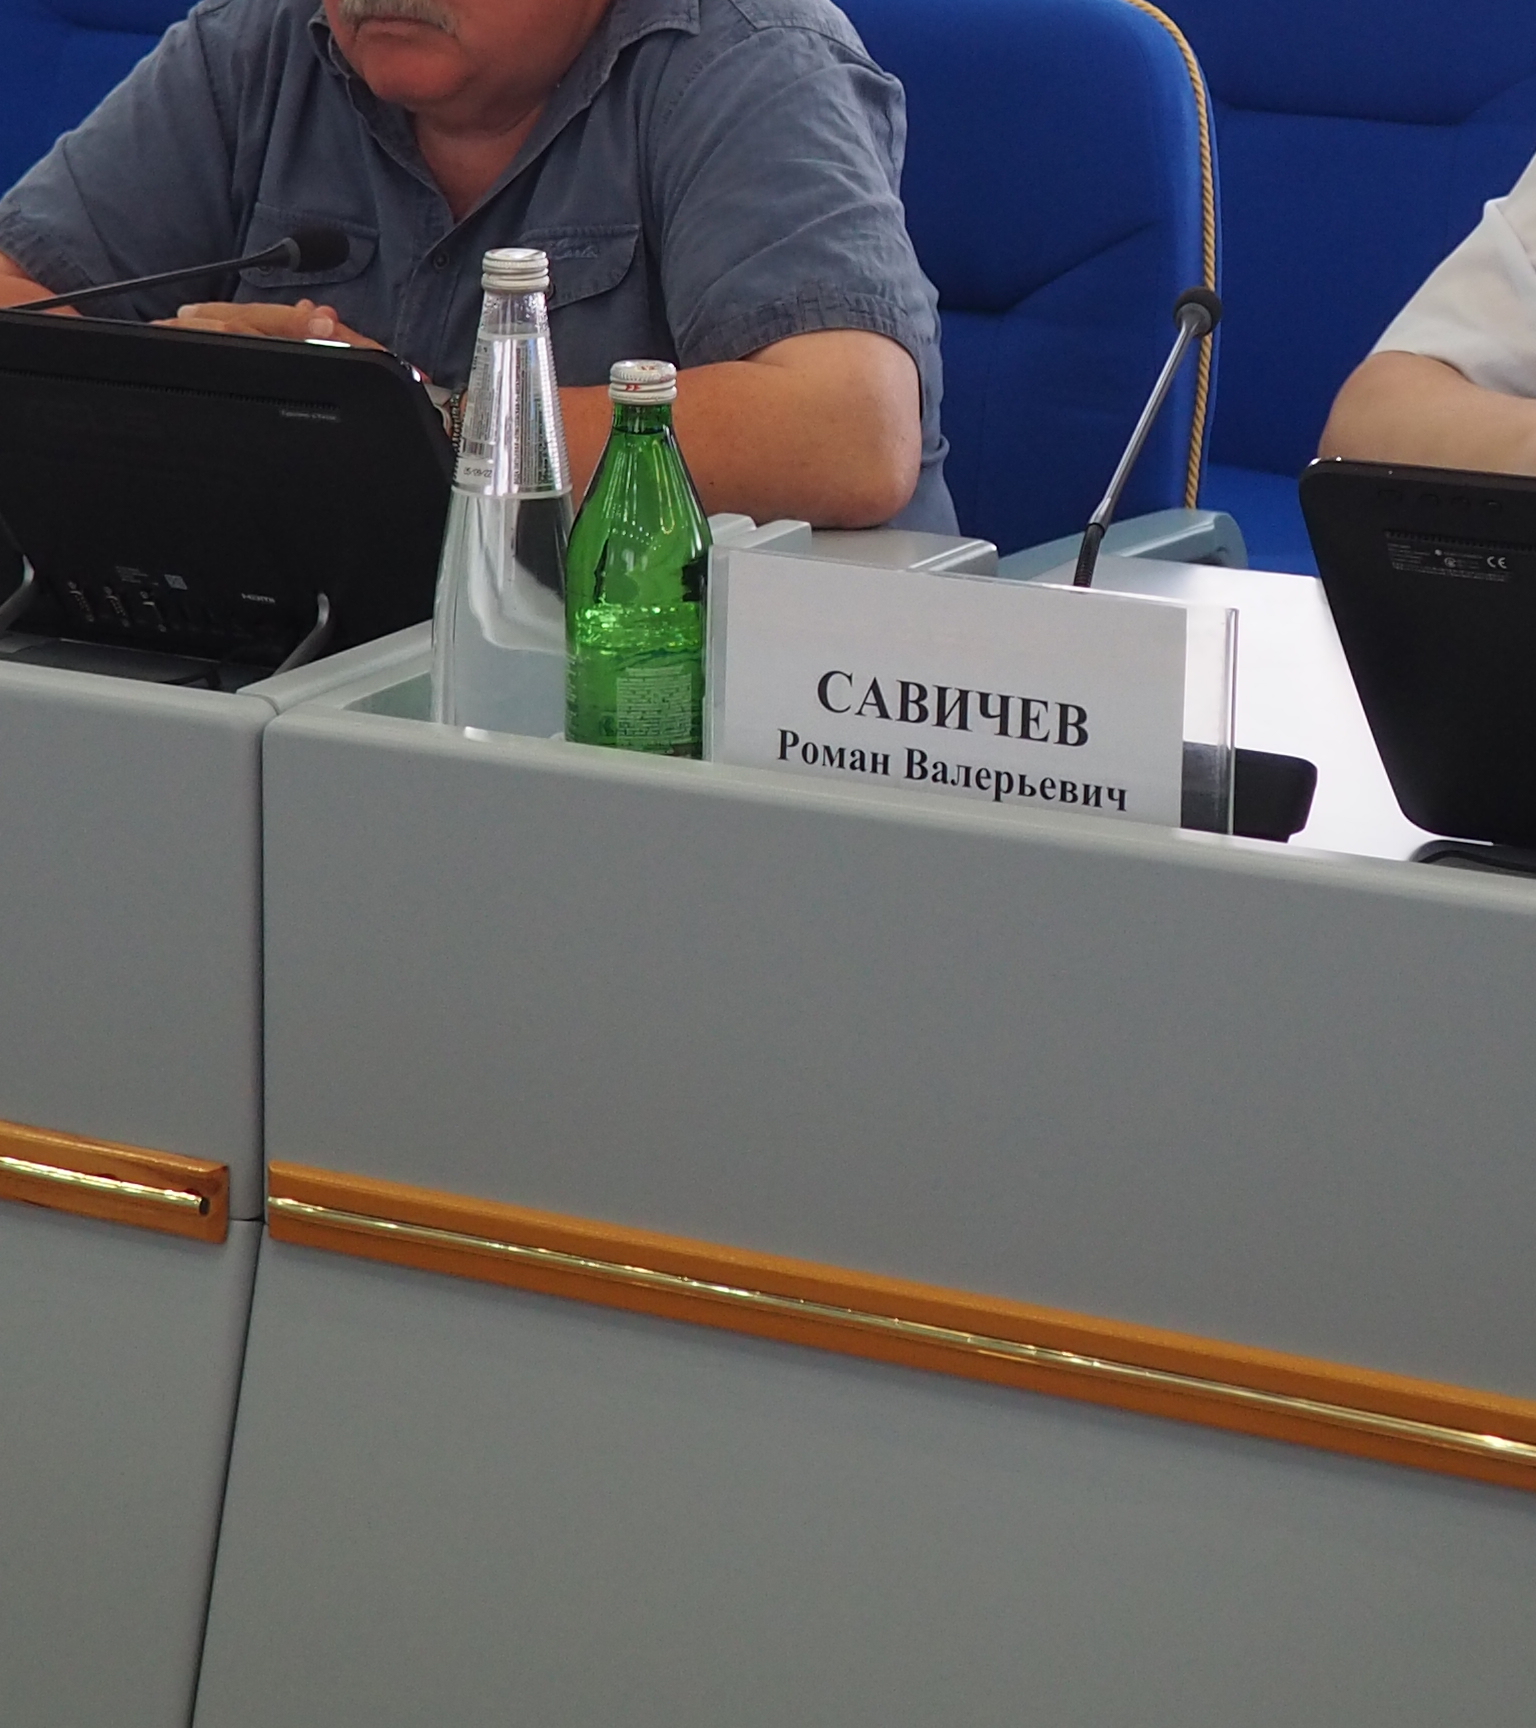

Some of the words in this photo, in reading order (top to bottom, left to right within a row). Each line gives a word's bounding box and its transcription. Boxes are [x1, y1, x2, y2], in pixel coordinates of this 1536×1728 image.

[817, 669, 1090, 749] САВИЧЕВ
[777, 728, 891, 777] Роман
[904, 747, 1129, 813] Валерьевич
